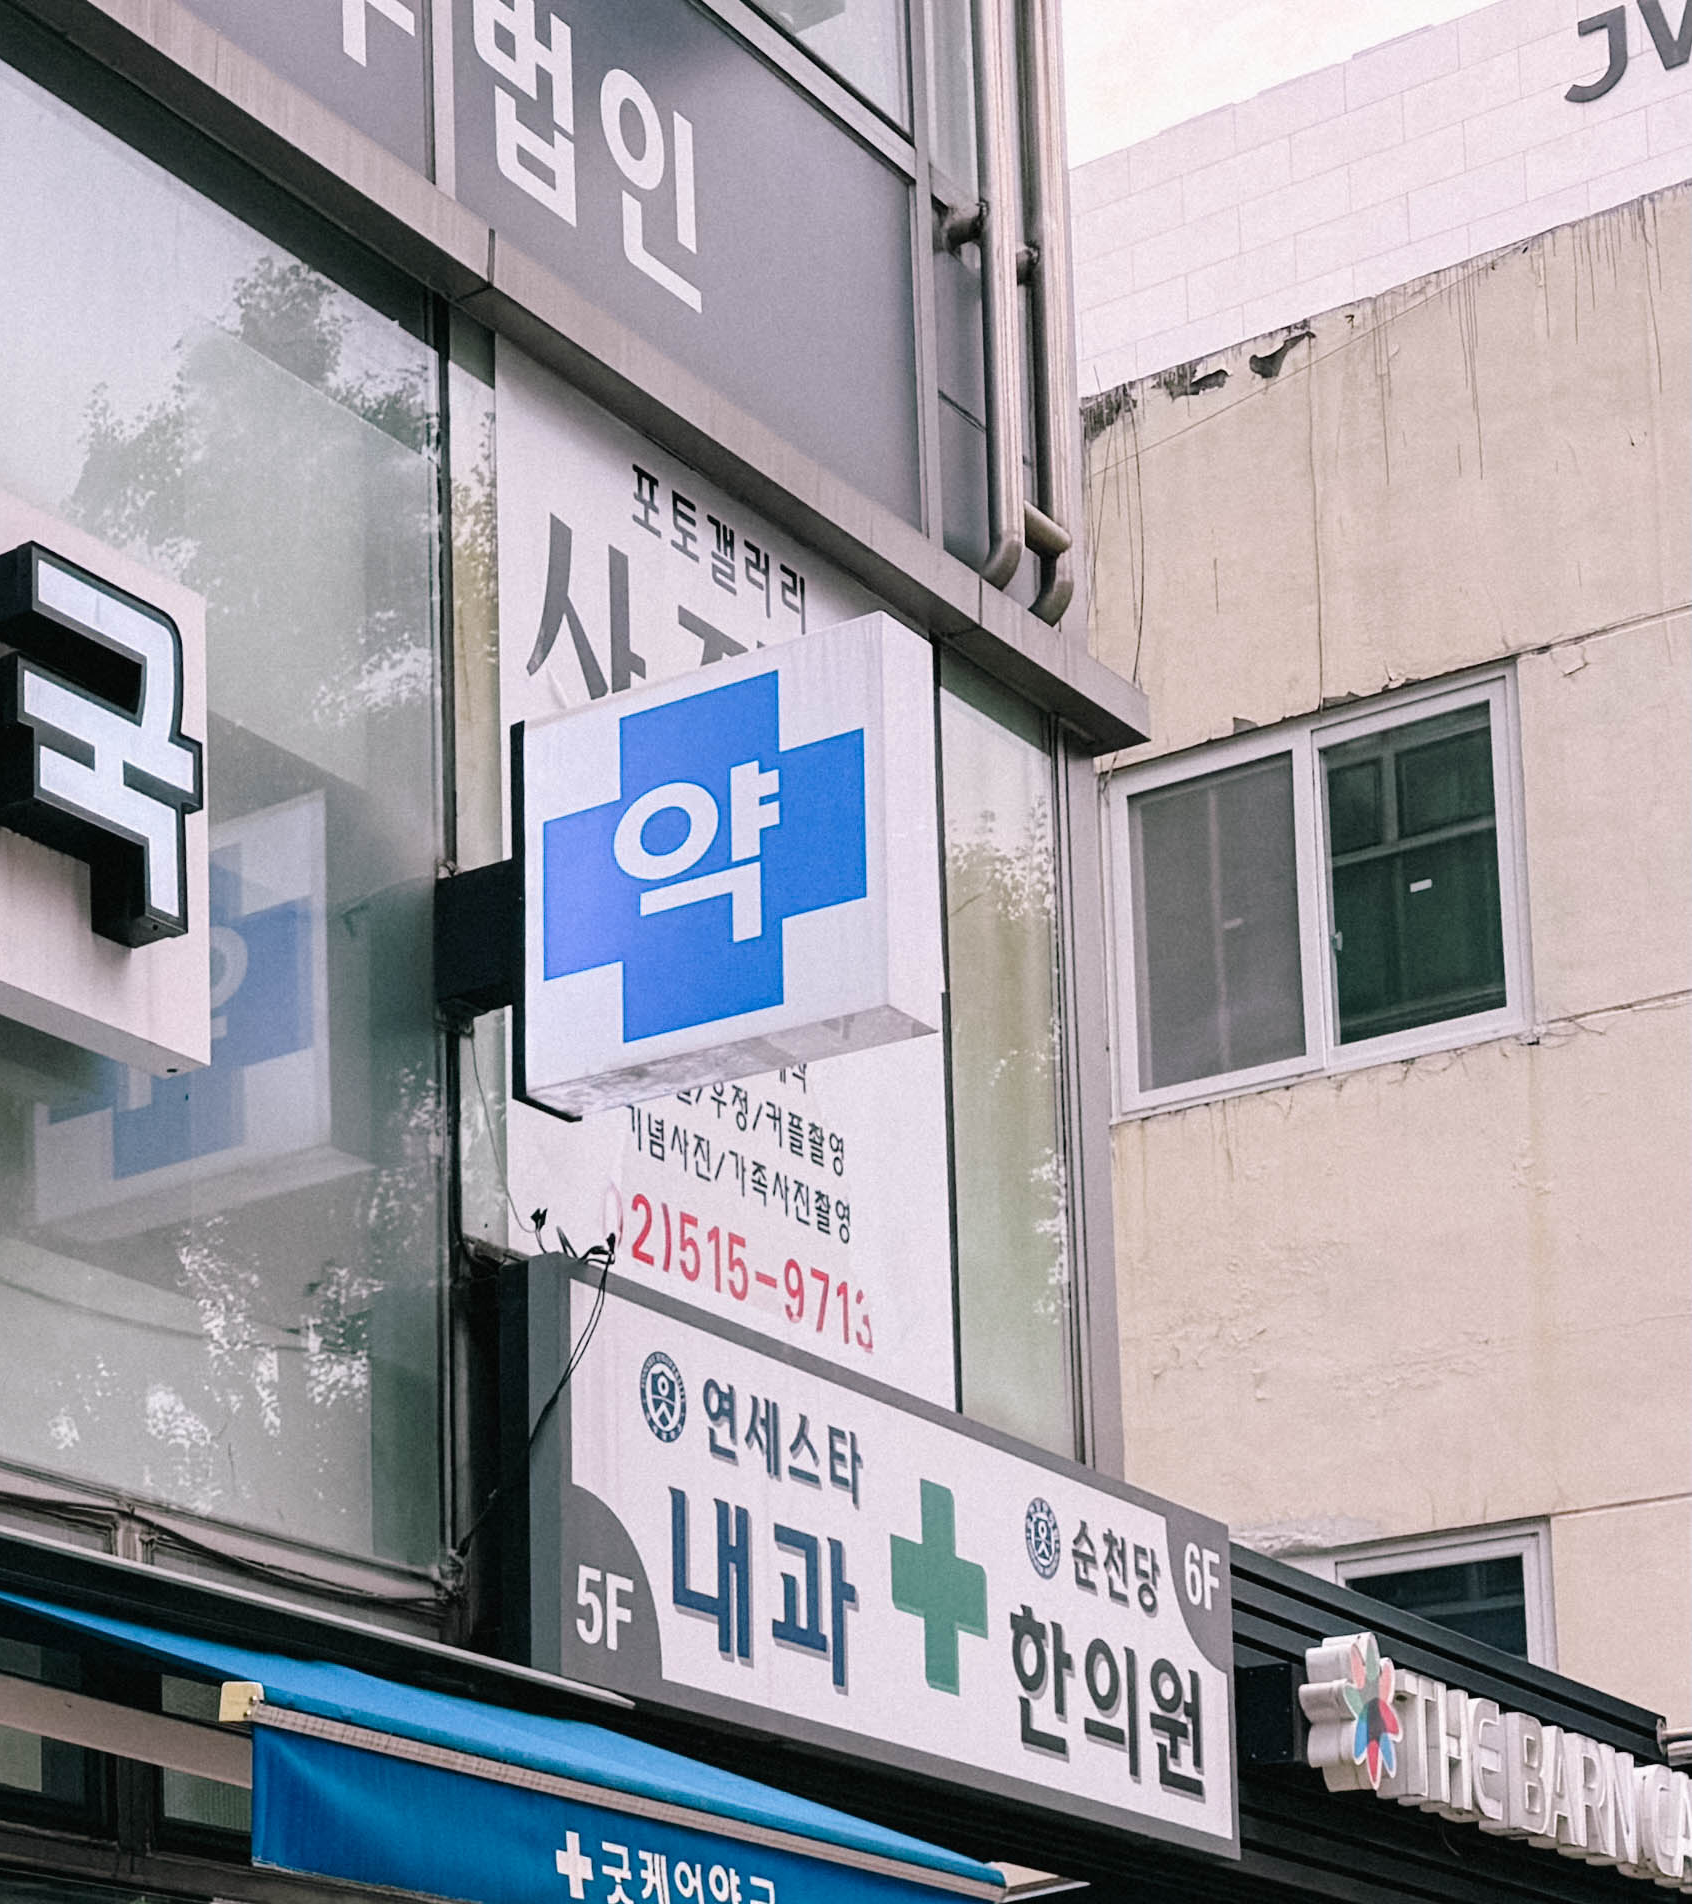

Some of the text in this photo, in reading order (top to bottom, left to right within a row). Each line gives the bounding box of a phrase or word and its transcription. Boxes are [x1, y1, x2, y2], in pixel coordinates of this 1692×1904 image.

[631, 463, 806, 634] 포토갤러리
[613, 760, 780, 944] 약
[627, 1104, 851, 1244] 기념사진/가족사진촬영
[702, 1376, 865, 1507] 연세스타
[575, 1566, 635, 1655] 5F
[668, 1487, 860, 1695] 내과
[1071, 1519, 1161, 1619] 순천당
[1184, 1541, 1220, 1612] 6F
[1009, 1603, 1206, 1804] 한의원
